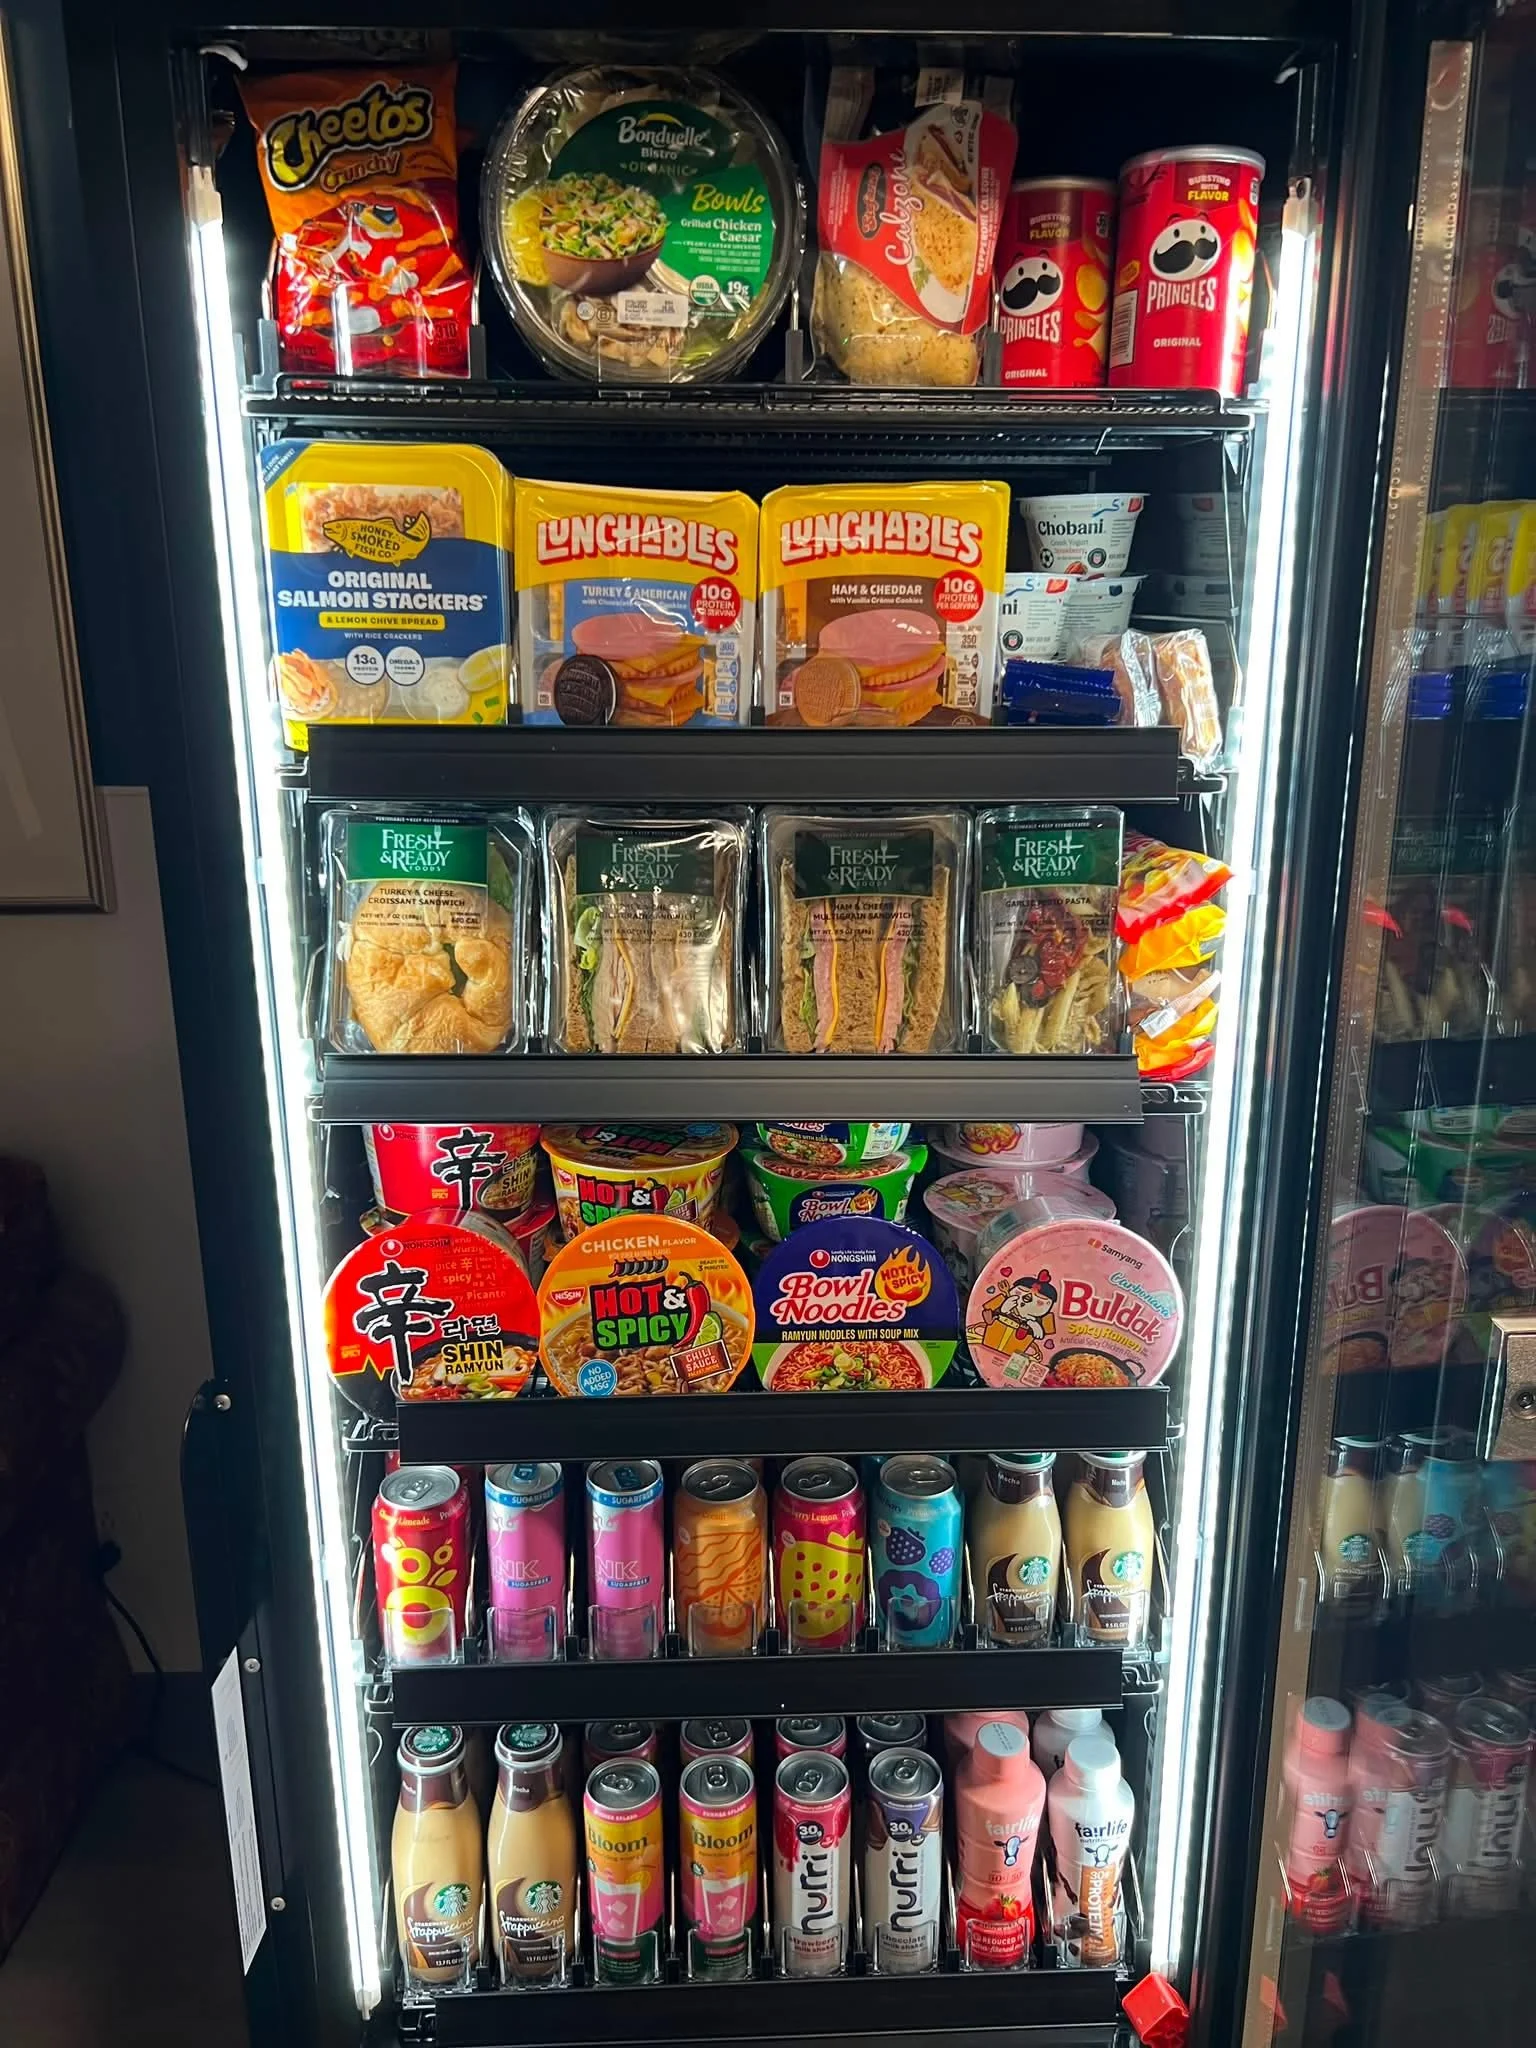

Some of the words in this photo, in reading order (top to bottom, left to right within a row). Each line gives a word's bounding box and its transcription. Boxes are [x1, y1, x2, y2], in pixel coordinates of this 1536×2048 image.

[268, 82, 431, 190] Cheetos
[616, 116, 706, 149] Bonduelle
[640, 147, 678, 160] Bistro
[320, 150, 400, 191] Crunchy
[1188, 174, 1231, 186] BURSTING
[1201, 183, 1219, 191] WITH
[692, 184, 765, 214] Bowls
[1188, 190, 1229, 202] FLAVOR
[681, 218, 712, 229] Grilled
[713, 218, 762, 233] Chicken
[719, 230, 762, 243] Caesar
[1029, 228, 1070, 240] FLAVOR
[976, 213, 989, 276] PEPPERONI
[727, 281, 749, 296] 19g
[1147, 278, 1217, 314] PRINGLES
[1153, 336, 1202, 349] ORIGINAL
[1005, 368, 1047, 380] ORIGINAL
[360, 524, 394, 539] HONEY
[1037, 519, 1104, 536] Chobani
[351, 531, 400, 552] SMOKED
[538, 513, 738, 574] LUNCHABLES
[781, 511, 984, 568] LUNCHABLES
[354, 544, 375, 557] FISH
[328, 571, 432, 590] ORIGINAL
[943, 577, 976, 593] 10G
[582, 585, 622, 599] TURKEY
[634, 587, 687, 601] AMERICAN
[700, 585, 732, 600] 10G
[832, 584, 857, 596] HAM
[859, 585, 868, 595] &
[870, 584, 922, 595] CHEDDAR
[278, 591, 370, 609] SALMON
[372, 592, 484, 612] STACKERS
[696, 601, 735, 610] PROTEIN
[846, 597, 871, 605] Vanilla
[895, 597, 924, 605] Cookies
[938, 593, 978, 603] PROTEIN
[335, 616, 368, 624] LEMON
[401, 617, 439, 626] SPREAD
[383, 632, 422, 640] CRACKERS
[961, 634, 977, 645] 350
[382, 828, 450, 852] FRESH
[1015, 836, 1080, 857] FRESH
[612, 843, 677, 864] FRESH
[830, 846, 894, 866] FRESH
[380, 888, 412, 897] TURKEY
[423, 889, 454, 897] CHEESE
[368, 898, 416, 906] CROISSANT
[418, 898, 465, 908] SANDWICH
[835, 903, 853, 911] HAM
[813, 913, 867, 921] MULTIGRAIN
[431, 1126, 507, 1211] 辛
[502, 1167, 530, 1190] SHIN
[578, 1178, 633, 1208] HOT
[632, 1189, 650, 1207] &
[802, 1198, 850, 1213] Bowl
[581, 1235, 660, 1254] CHICKEN
[662, 1237, 697, 1247] FLAVOR
[831, 1254, 877, 1263] NONGSHIM
[443, 1273, 472, 1285] spicy
[881, 1266, 908, 1281] HOT
[891, 1272, 926, 1289] SPICY
[780, 1269, 875, 1300] Bowl
[594, 1284, 664, 1320] HOT
[663, 1288, 688, 1310] &
[1109, 1271, 1171, 1319] Carbonara
[770, 1295, 907, 1325] Noodles
[1060, 1279, 1163, 1346] Buldak
[354, 1261, 452, 1384] 辛
[440, 1315, 500, 1341] 라면
[596, 1312, 690, 1348] SPICY
[782, 1330, 818, 1341] RAMYUN
[818, 1330, 856, 1341] NOODLES
[857, 1329, 878, 1340] WITH
[880, 1329, 902, 1339] SOUP
[903, 1328, 919, 1338] MIX
[1067, 1323, 1102, 1342] Spicy
[1102, 1329, 1143, 1354] Ramen
[1060, 1337, 1086, 1346] Artificial
[1086, 1339, 1102, 1349] Spicy
[442, 1341, 504, 1365] SHIN
[685, 1347, 712, 1362] CHILI
[445, 1360, 504, 1376] RAMYUN
[588, 1366, 602, 1376] NO
[685, 1355, 718, 1372] SAUCE
[583, 1371, 612, 1388] ADDED
[590, 1380, 609, 1392] MSG
[998, 1473, 1021, 1486] Mocha
[511, 1490, 555, 1505] SUGARFREE
[611, 1491, 654, 1505] SUGARFREE
[811, 1512, 838, 1521] Lemon
[511, 1578, 549, 1588] SUGARFREE
[610, 1579, 648, 1588] SUGARFREE
[799, 1824, 823, 1838] 30g
[889, 1821, 913, 1836] 30g
[588, 1824, 648, 1853] Bloom
[692, 1824, 753, 1851] Bloom
[800, 1852, 834, 1936] nurri
[889, 1850, 923, 1934] nurri
[1087, 1879, 1104, 1943] PROTEIN
[406, 1915, 474, 1943] frappuccino
[500, 1910, 565, 1938] frappuccino
[880, 1934, 927, 1945] chocolate
[882, 1941, 900, 1949] milk
[983, 1936, 1016, 1946] REDUCED
[794, 1945, 812, 1953] milk
